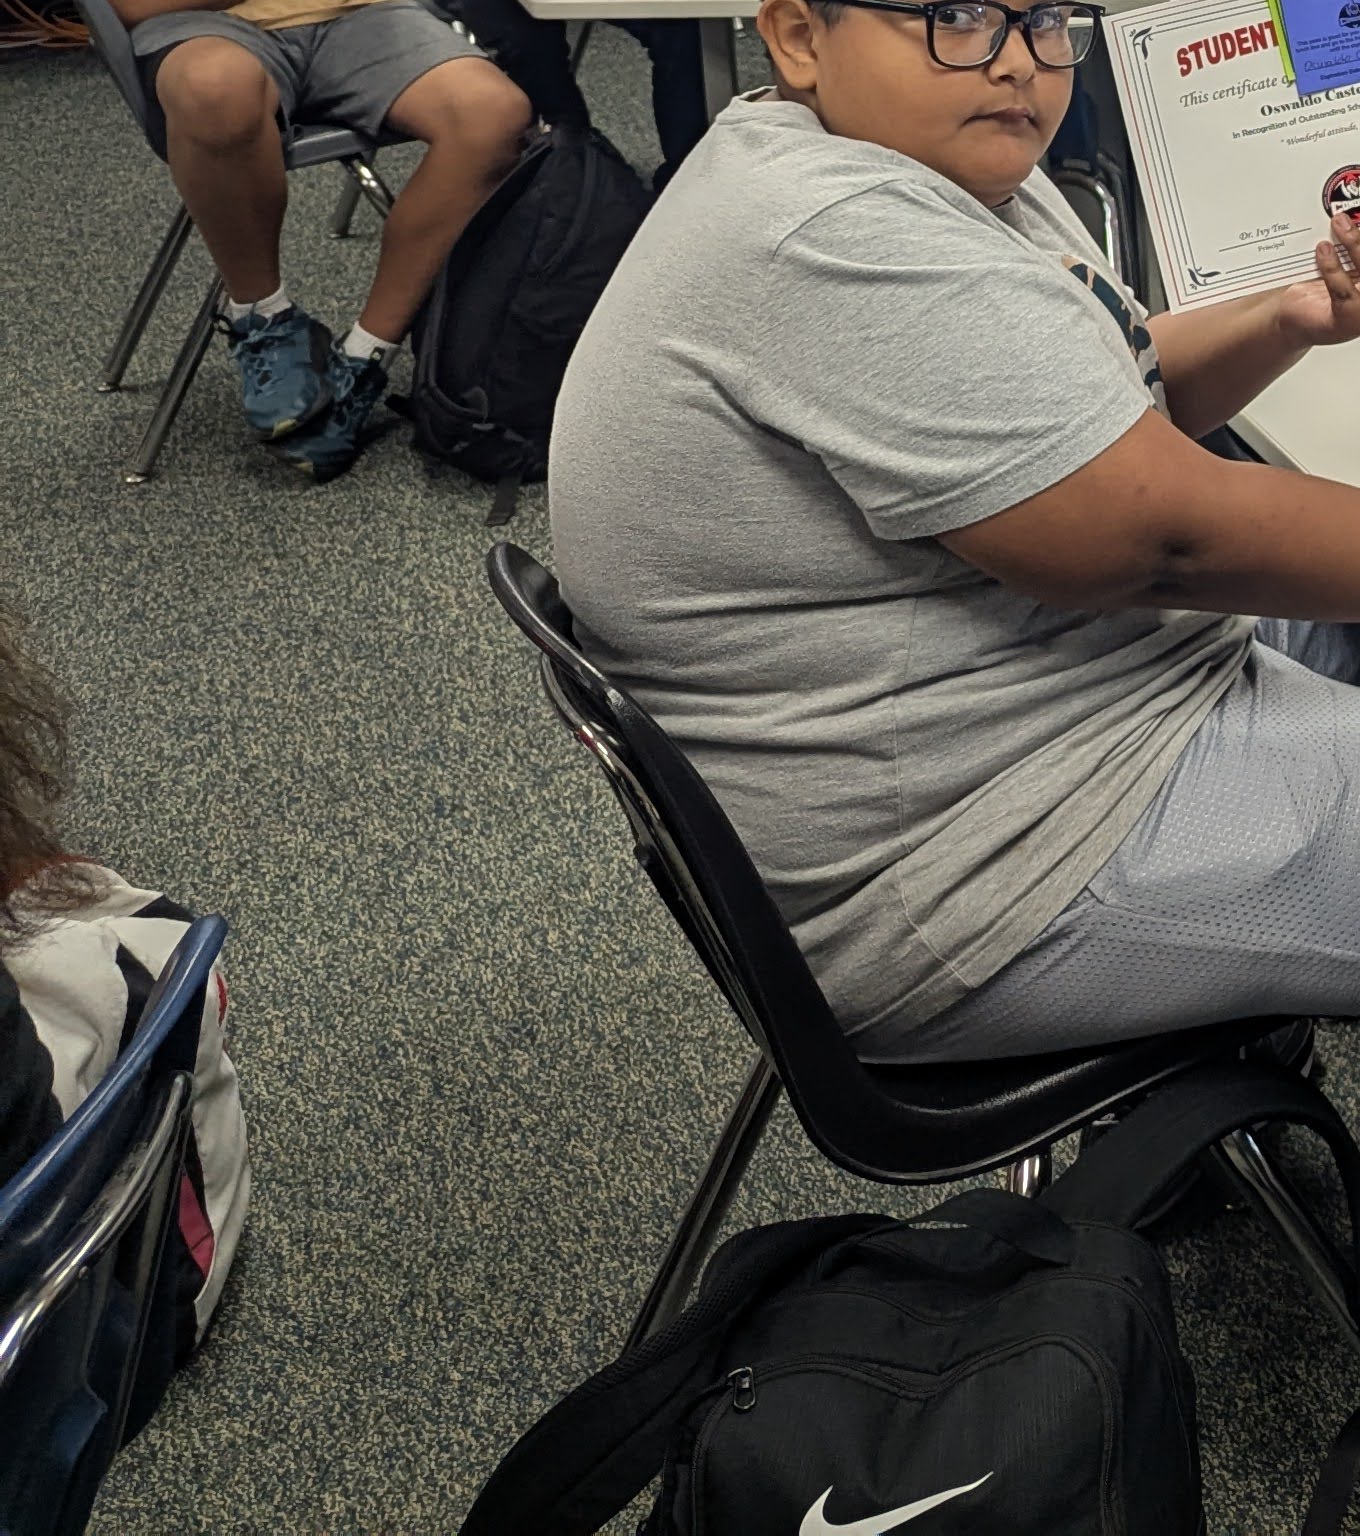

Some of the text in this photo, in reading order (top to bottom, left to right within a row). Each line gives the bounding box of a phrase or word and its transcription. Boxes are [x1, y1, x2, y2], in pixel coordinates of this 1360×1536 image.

[1176, 19, 1280, 77] STUDENT
[1180, 76, 1278, 109] This certificate
[1260, 94, 1322, 117] Oswaldo
[1242, 119, 1288, 139] Recognition
[1298, 106, 1347, 126] Outstanding
